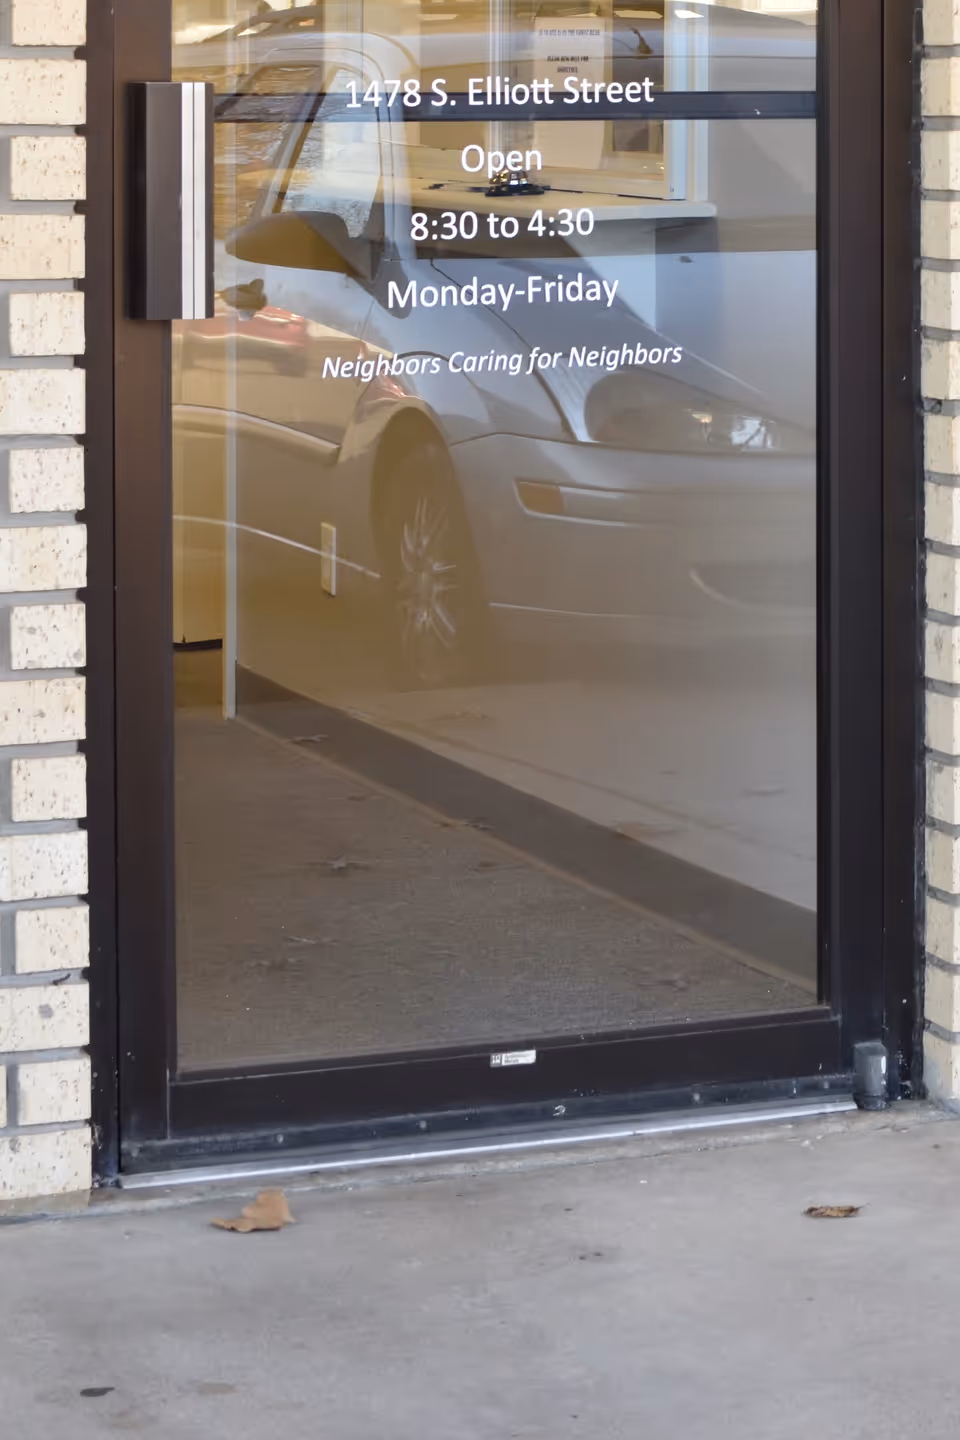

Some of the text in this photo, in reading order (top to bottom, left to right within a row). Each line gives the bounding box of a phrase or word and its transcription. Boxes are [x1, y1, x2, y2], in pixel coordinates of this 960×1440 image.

[345, 75, 655, 109] 1478 S. Elliott Street
[461, 143, 543, 178] Open
[410, 208, 595, 241] 8:30 to 4:30
[387, 272, 619, 311] Monday-Friday
[321, 342, 683, 382] Neighbors Caring for Neighbors
